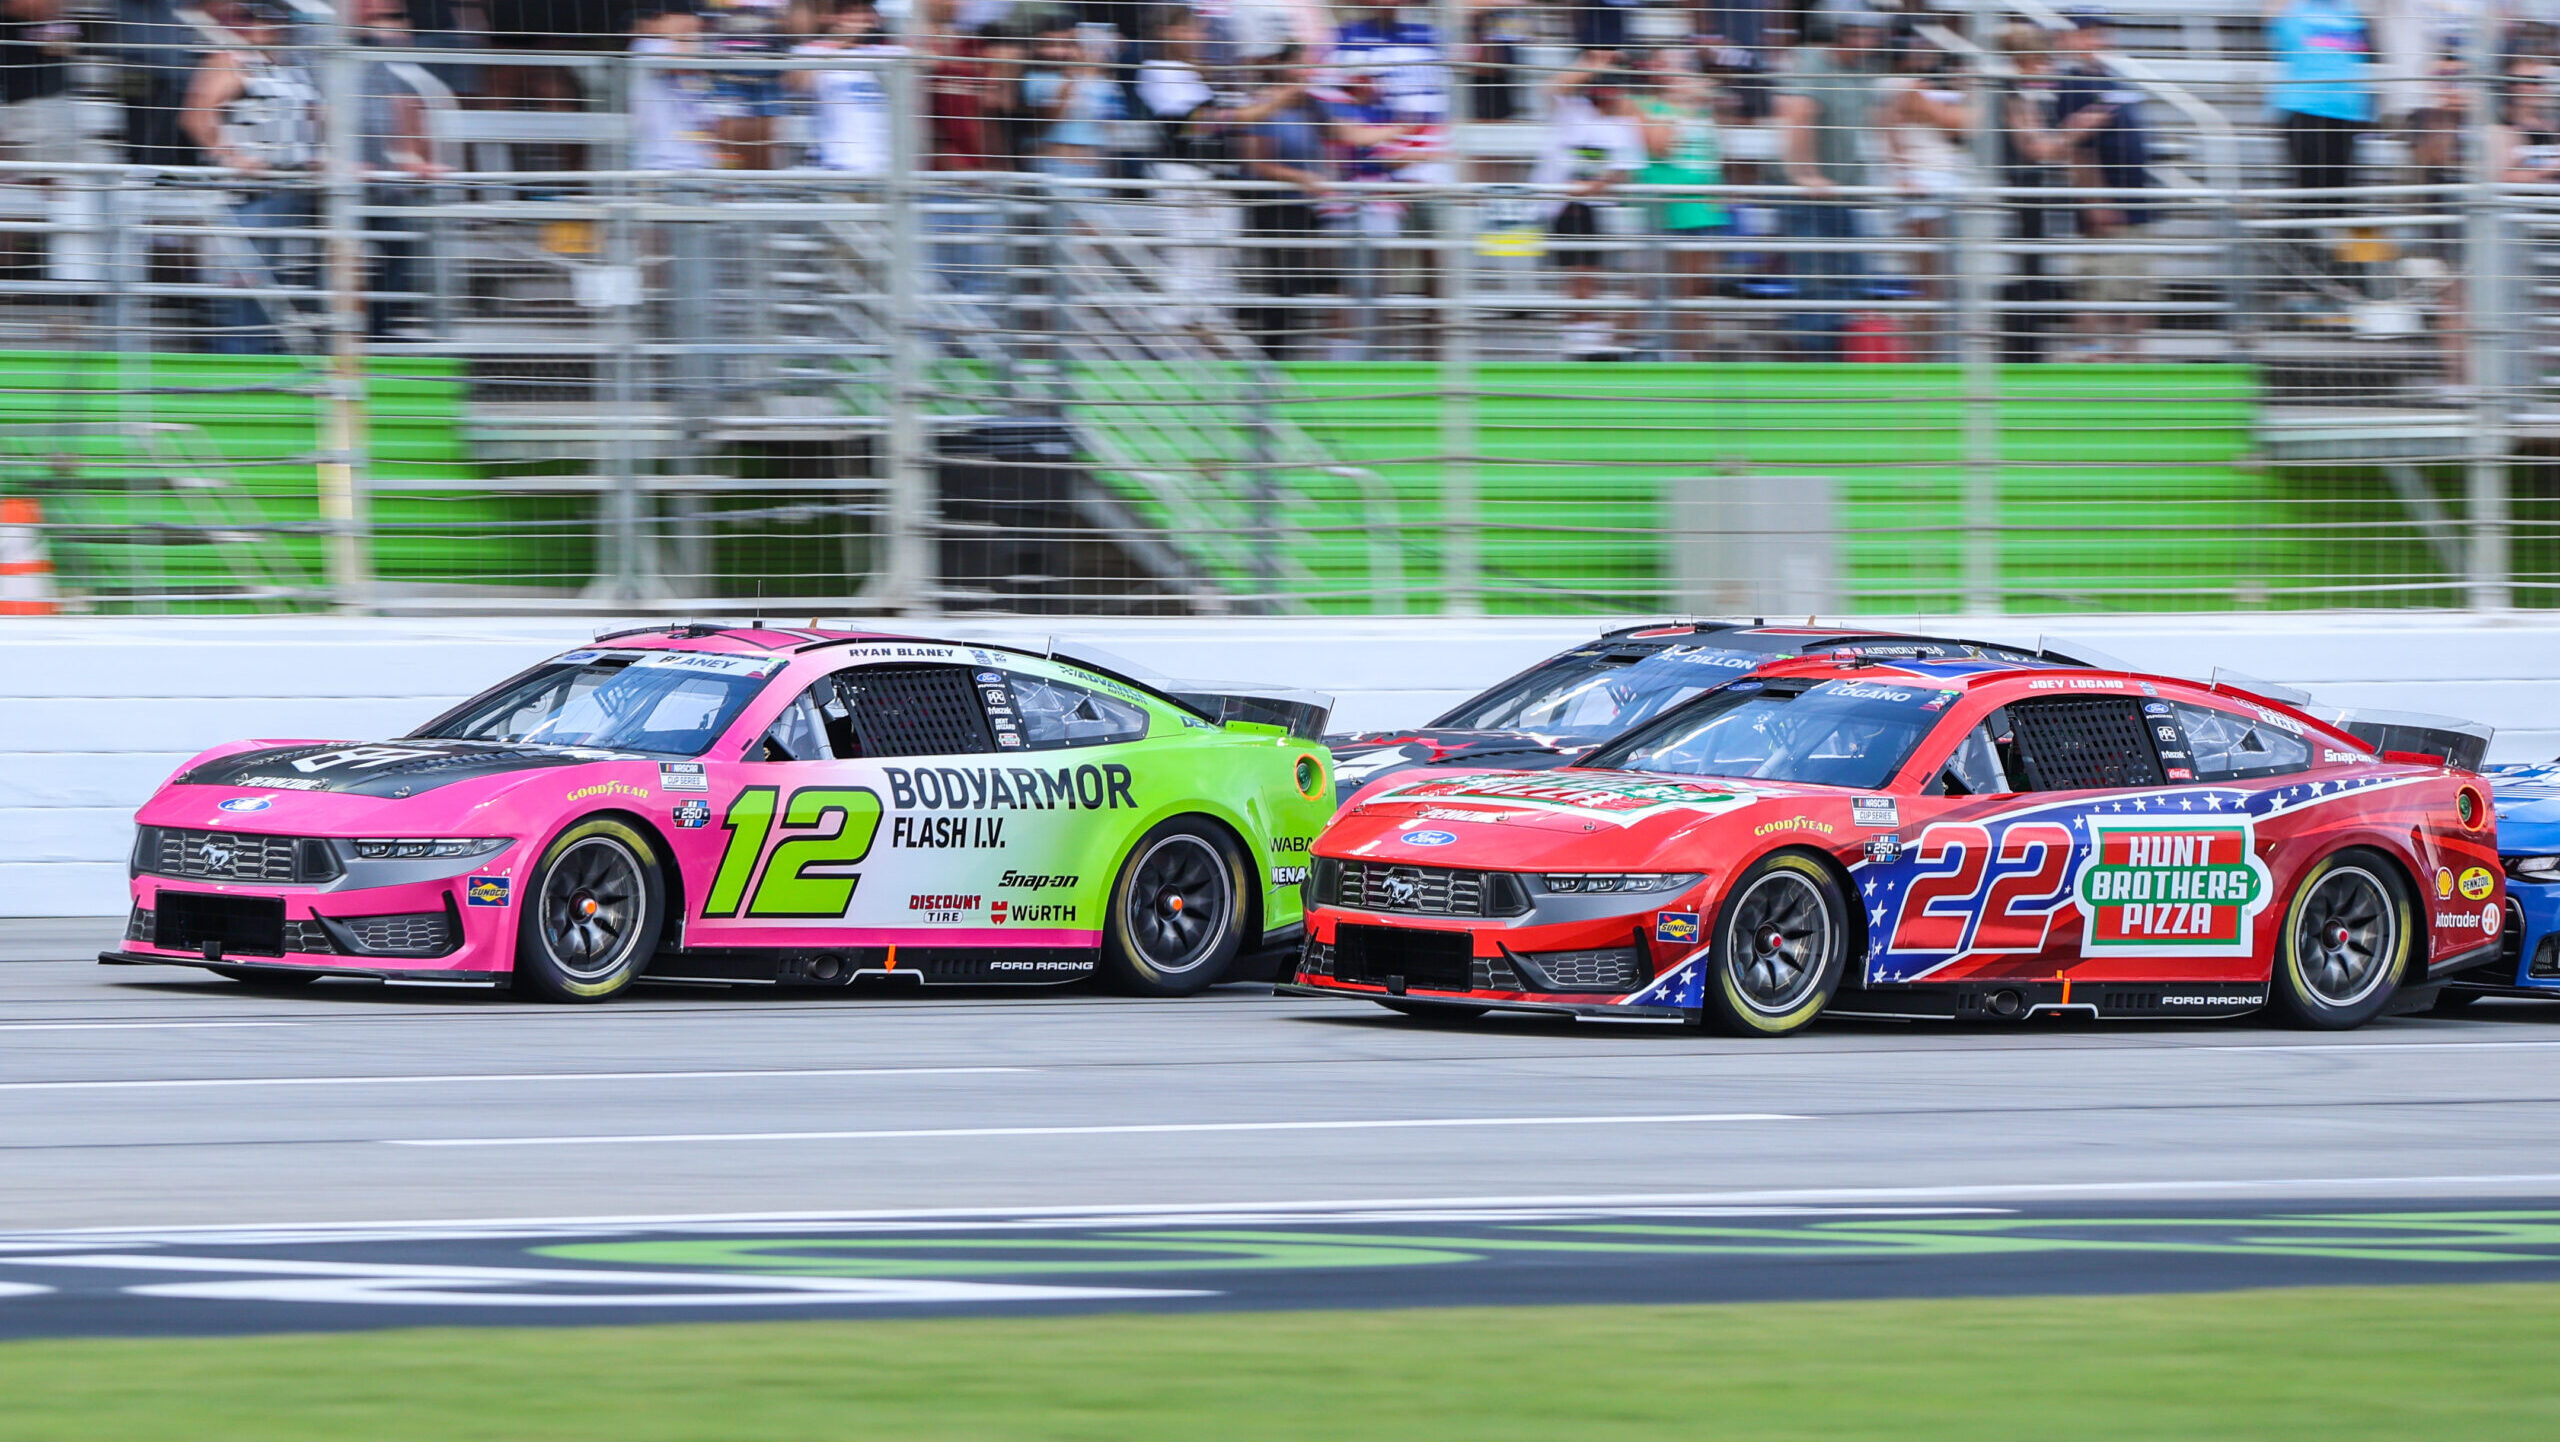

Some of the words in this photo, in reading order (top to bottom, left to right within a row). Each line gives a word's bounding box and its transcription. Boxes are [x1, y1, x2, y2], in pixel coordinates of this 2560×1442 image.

[850, 648, 891, 656] RYAN
[897, 648, 954, 657] BLANEY
[658, 656, 739, 669] BLANEY
[1682, 653, 1757, 670] DILLON
[2029, 680, 2064, 689] JOEY
[2069, 680, 2124, 689] LOGANO
[1826, 686, 1912, 702] LOGANO
[2324, 749, 2371, 765] Snap-on
[672, 764, 699, 773] NASCAR
[667, 777, 679, 785] CUP
[680, 777, 700, 785] SERIES
[882, 763, 1139, 810] BODYARMOR
[566, 780, 649, 801] GOODYEAR
[1865, 799, 1889, 807] NASCAR
[681, 808, 702, 819] 250
[1860, 811, 1871, 819] CUP
[1872, 811, 1891, 820] SERIES
[892, 818, 967, 848] FLASH
[974, 817, 1006, 848] I.V.
[1754, 815, 1834, 836] GOODYEAR
[700, 785, 884, 919] 12
[1873, 843, 1893, 854] 250
[2129, 836, 2215, 867] HUNT
[998, 870, 1079, 891] Snap-on
[1886, 821, 2075, 955] 22
[2092, 870, 2248, 900] BROTHERS
[2463, 875, 2490, 891] PENNZOIL
[471, 888, 507, 897] SUNOCO
[909, 894, 982, 910] DISCOUNT
[928, 912, 960, 922] TIRE
[2121, 903, 2212, 935] PIZZA
[1661, 923, 1695, 932] SUNOCO
[990, 961, 1033, 970] FORD
[1036, 961, 1094, 970] RACING
[2162, 996, 2204, 1005] FORD
[2207, 996, 2263, 1005] RACING
